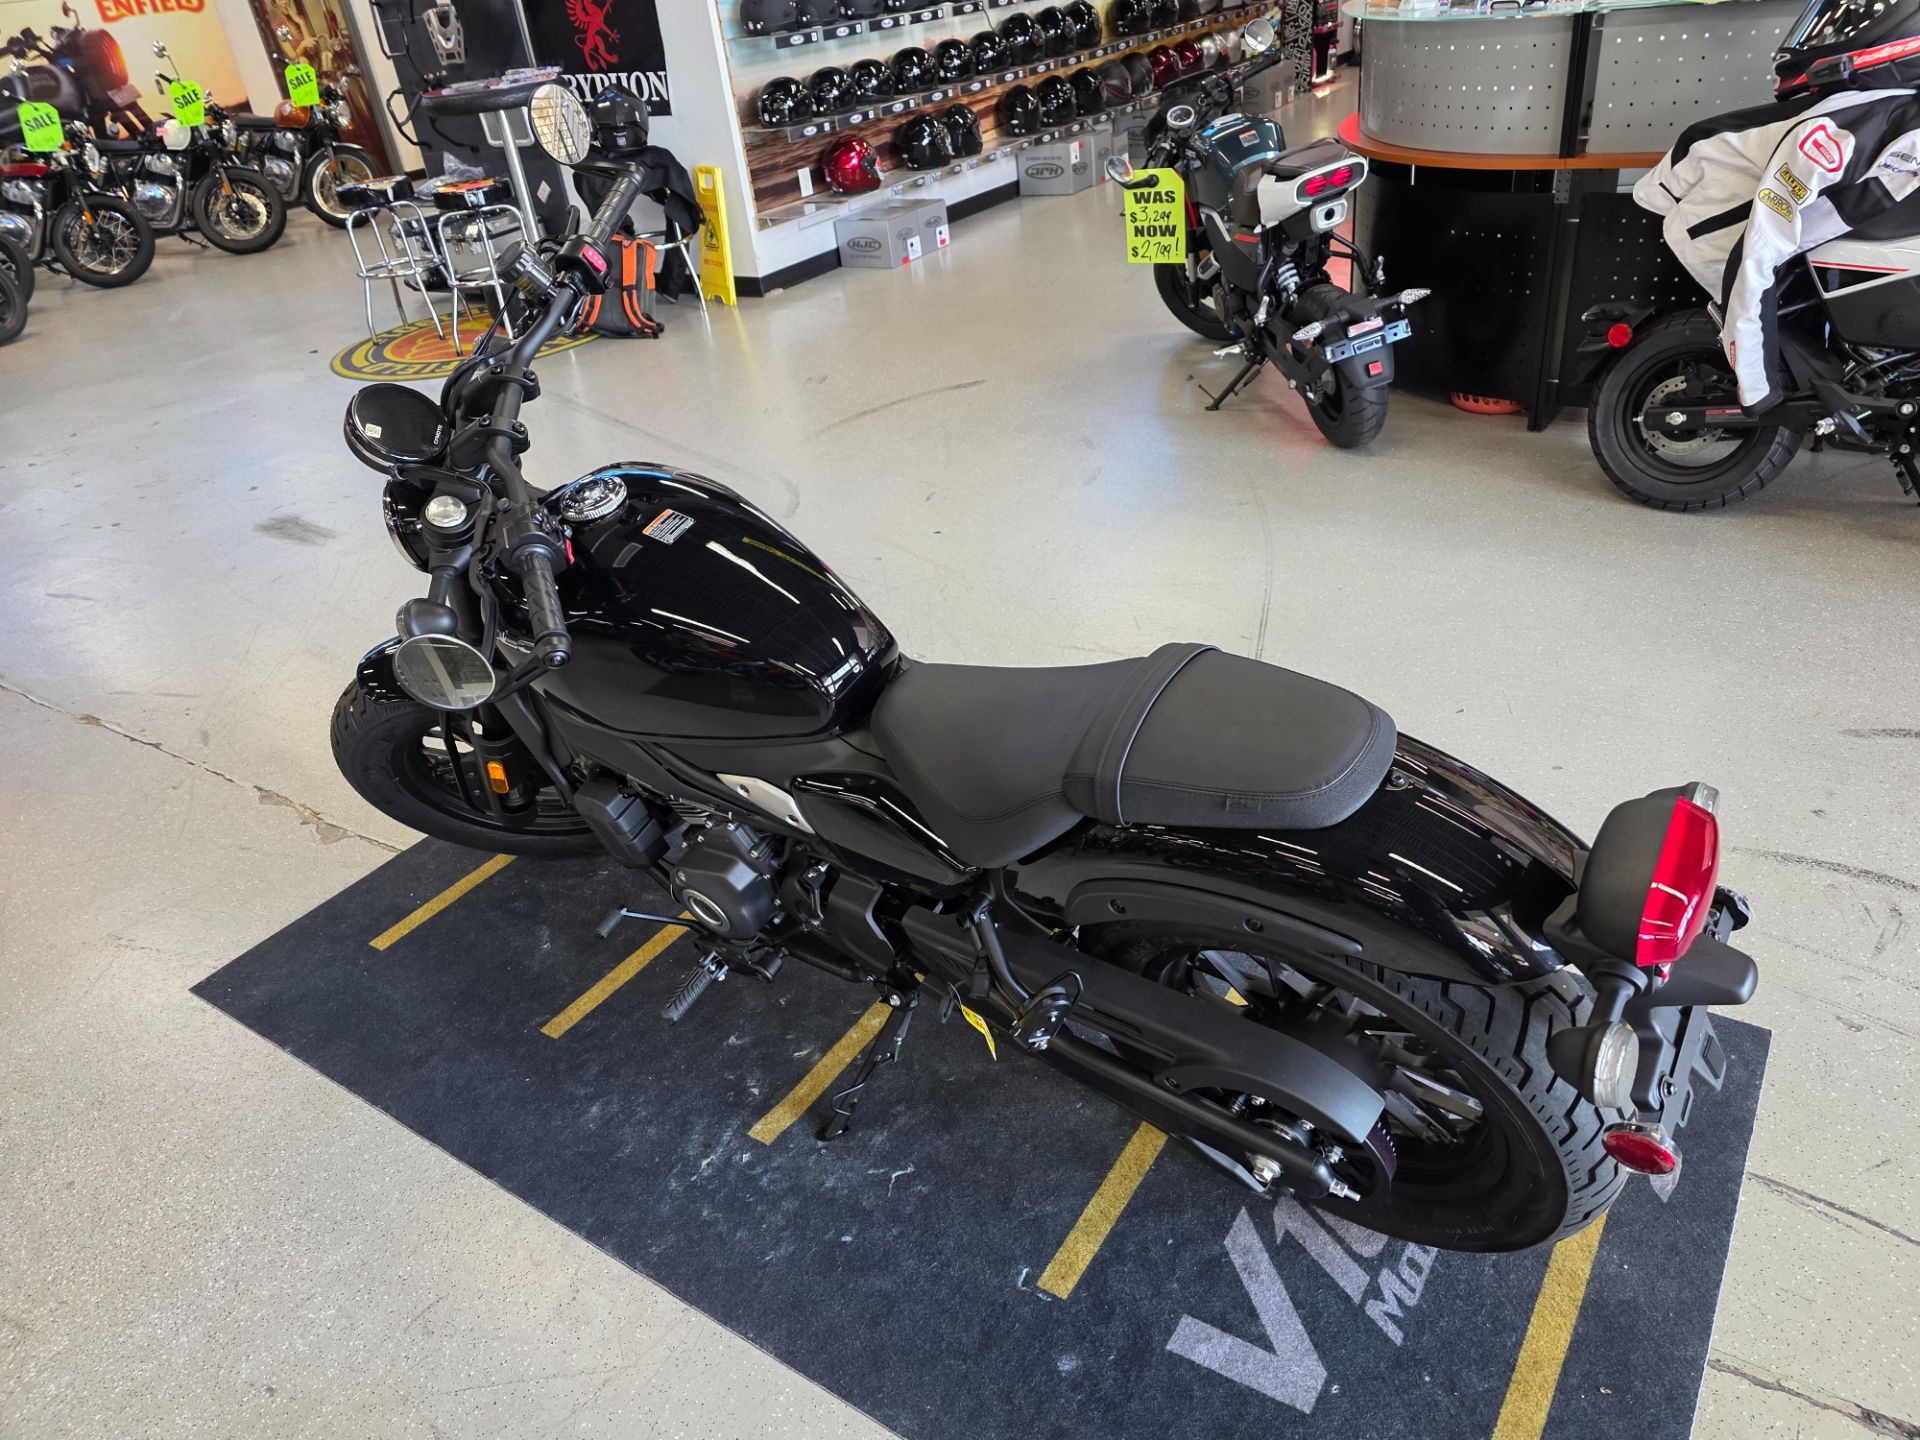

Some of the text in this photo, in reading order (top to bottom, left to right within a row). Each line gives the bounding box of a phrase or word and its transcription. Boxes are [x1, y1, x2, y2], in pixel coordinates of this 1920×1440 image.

[289, 72, 314, 90] SALE
[560, 71, 670, 102] RYPON
[173, 89, 201, 109] SALE
[24, 112, 57, 132] SALE
[1133, 190, 1176, 204] WAS
[1134, 224, 1177, 237] NOW
[1165, 1196, 1390, 1415] V1
